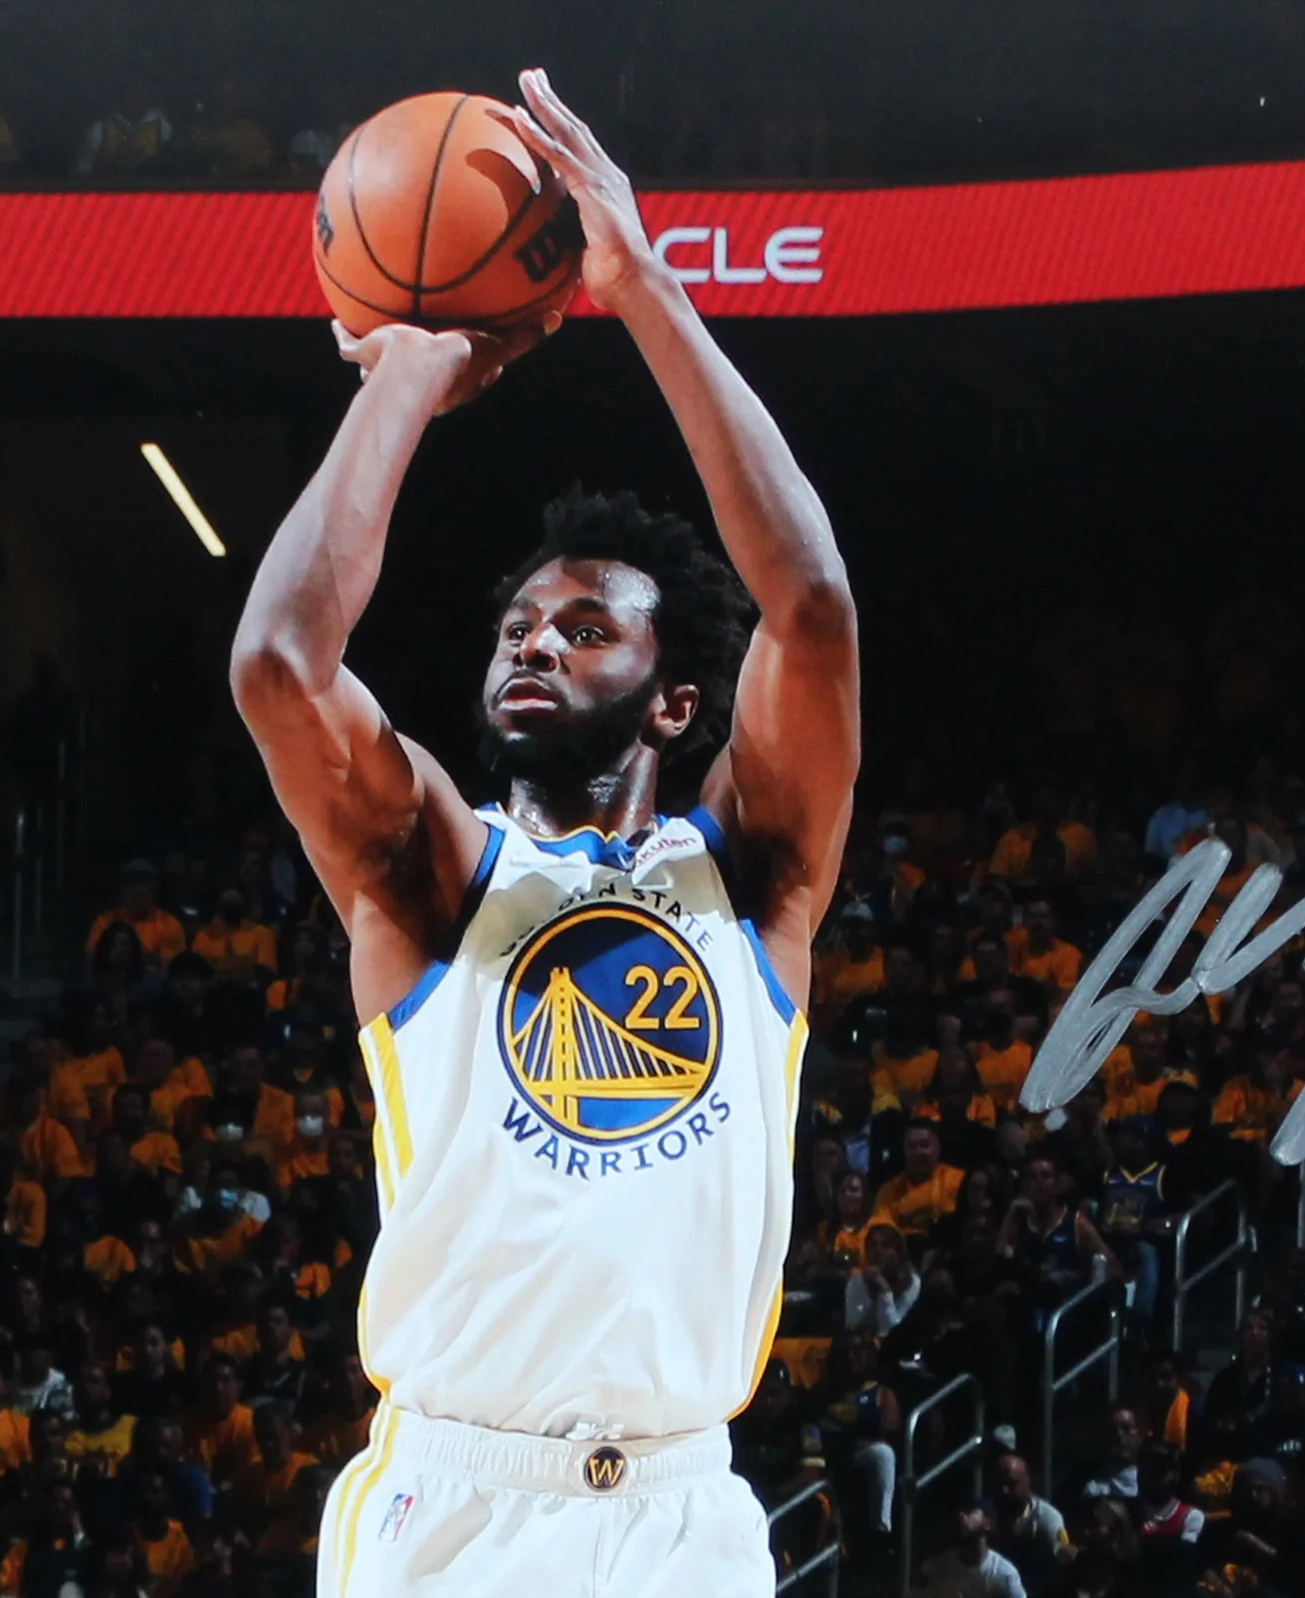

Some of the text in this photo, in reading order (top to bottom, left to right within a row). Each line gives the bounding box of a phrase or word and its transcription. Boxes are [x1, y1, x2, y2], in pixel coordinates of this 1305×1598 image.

[652, 226, 824, 284] CLE
[632, 888, 714, 951] STATE
[624, 965, 700, 1029] 22
[501, 1092, 731, 1182] WARRIORS
[589, 1458, 624, 1488] W
